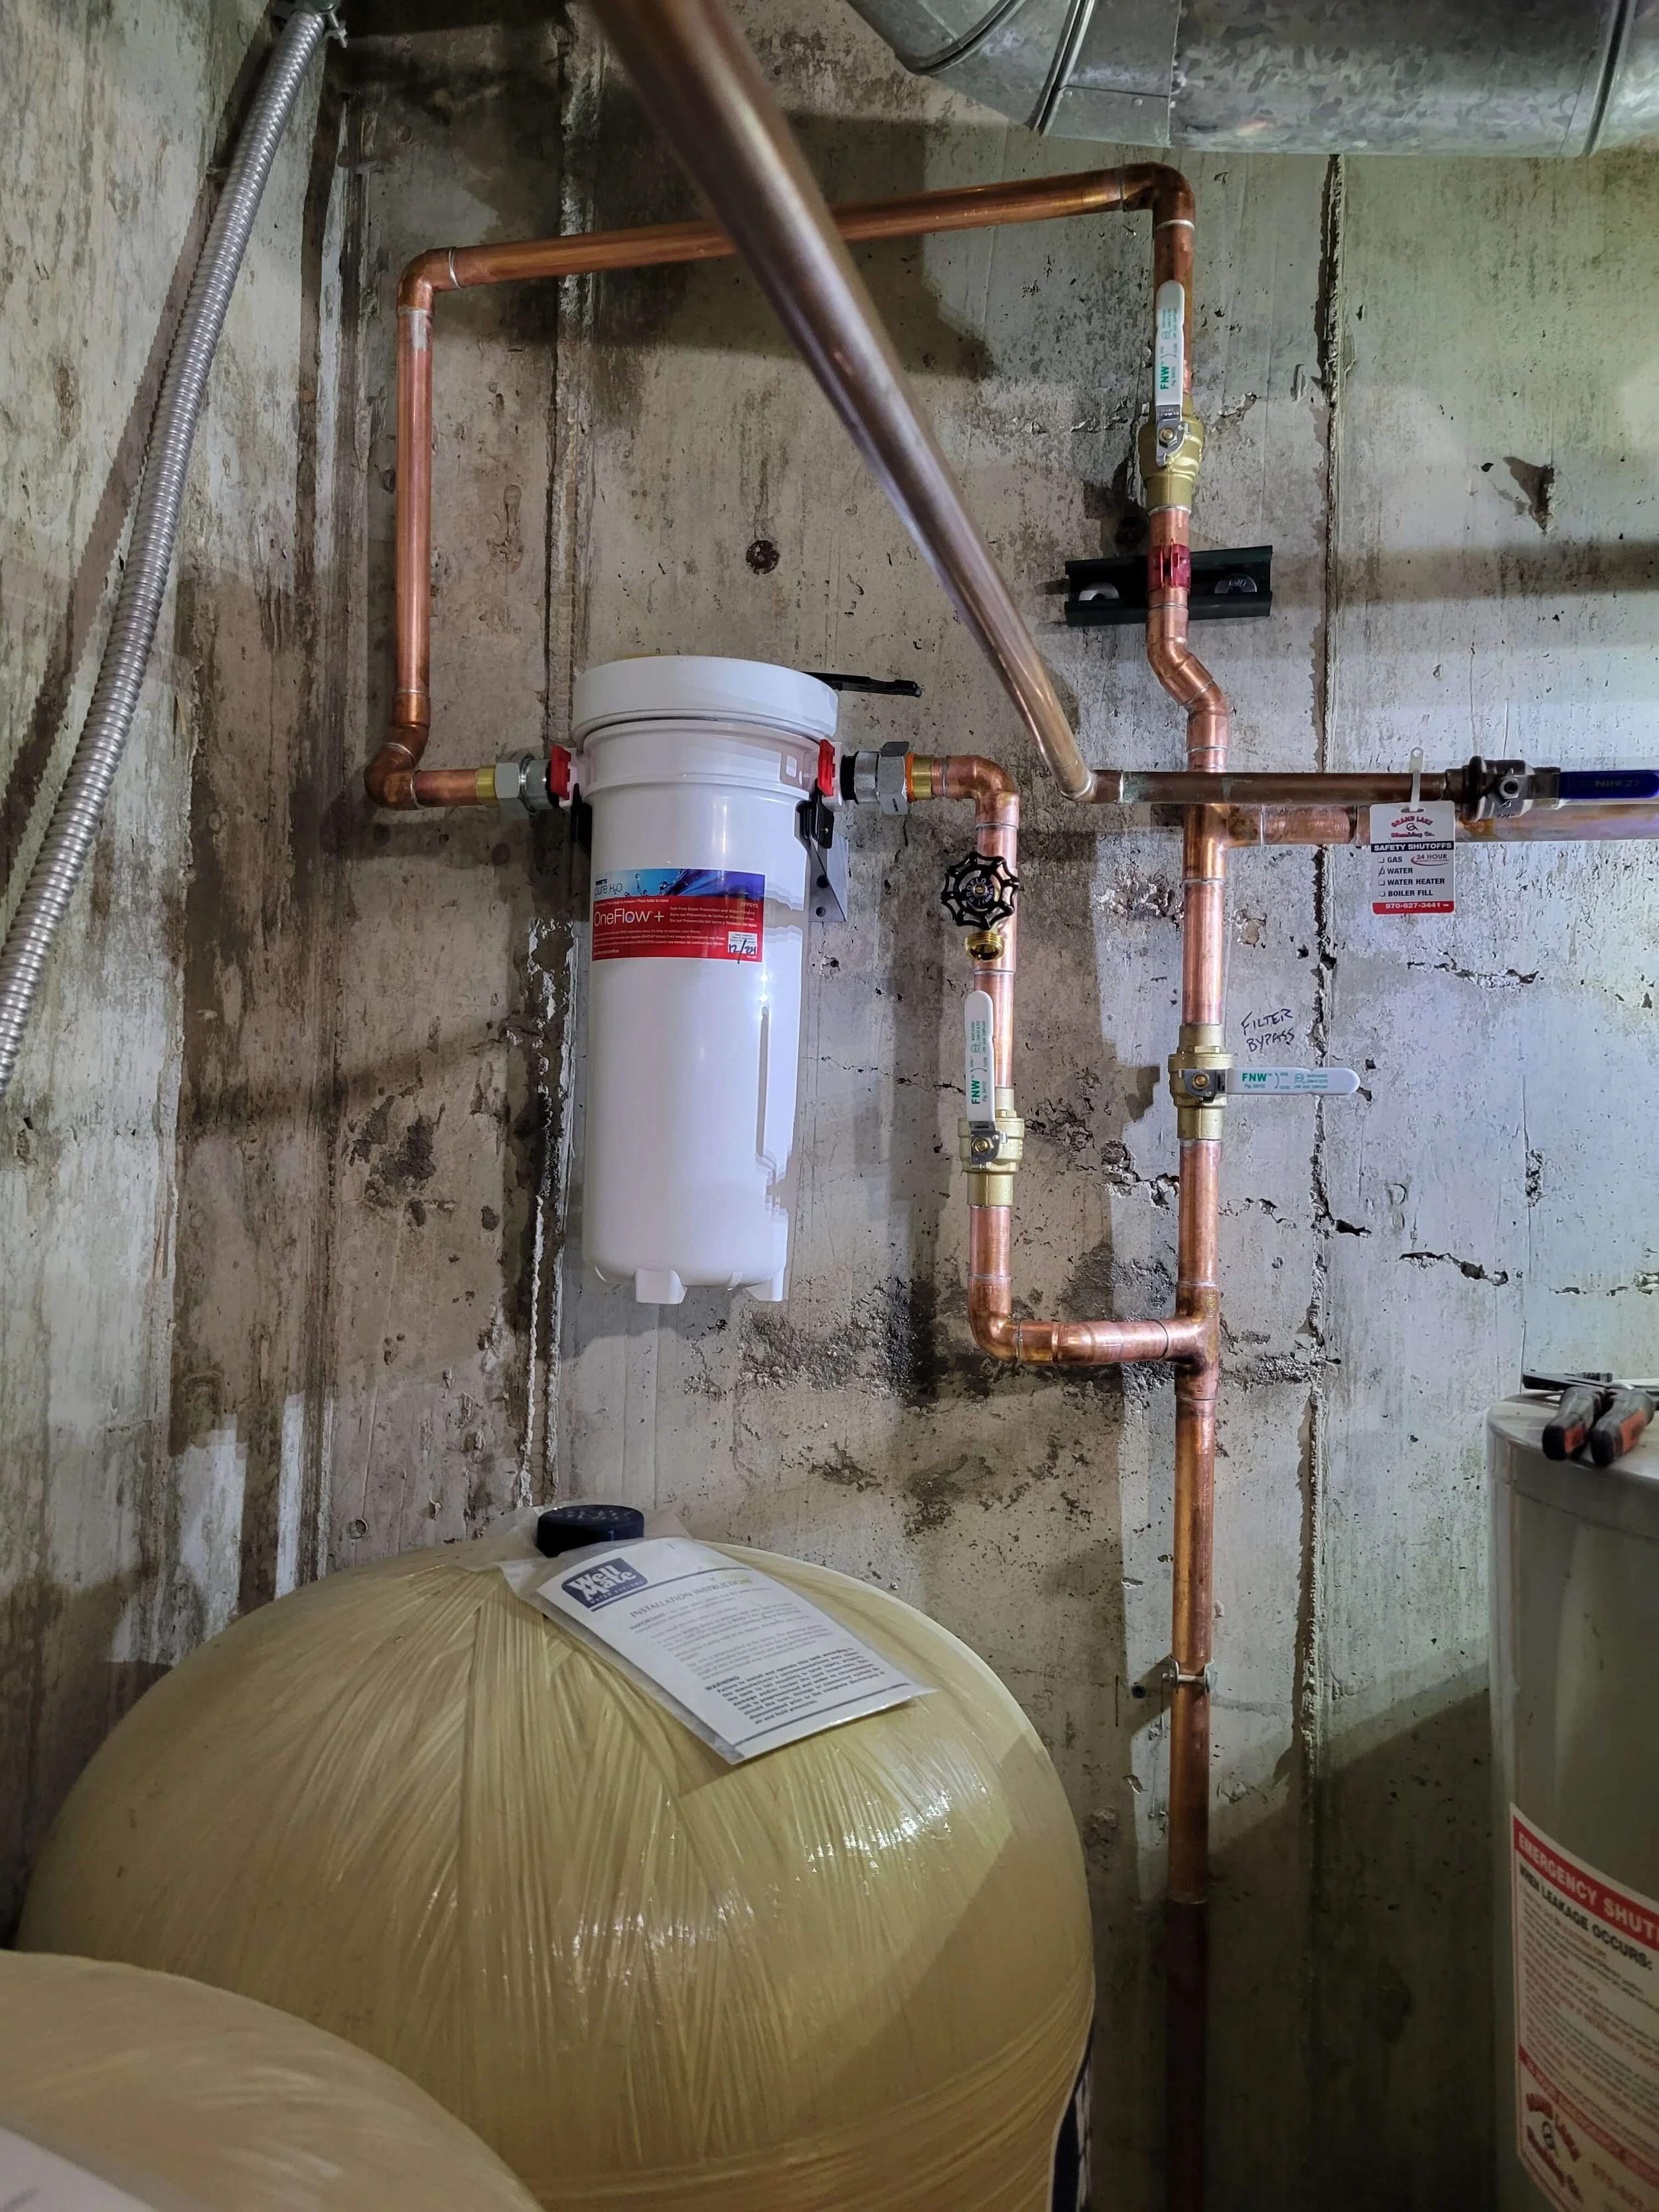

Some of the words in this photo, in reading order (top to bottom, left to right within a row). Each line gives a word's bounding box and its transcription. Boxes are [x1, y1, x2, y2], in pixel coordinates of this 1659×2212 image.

[1391, 816, 1415, 828] GRAND
[966, 878, 986, 902] PROFLO
[1241, 1008, 1293, 1035] FILTER
[1246, 1027, 1295, 1052] BYPASS
[566, 1564, 621, 1591] Well
[582, 1572, 637, 1601] Mate
[630, 1591, 693, 1618] INSTALLATION
[693, 1579, 750, 1595] INSTRUCTI
[1519, 1831, 1597, 1905] EMERGENCY
[1604, 1897, 1659, 1945] SHUT
[1542, 1885, 1589, 1933] LEAKAGE
